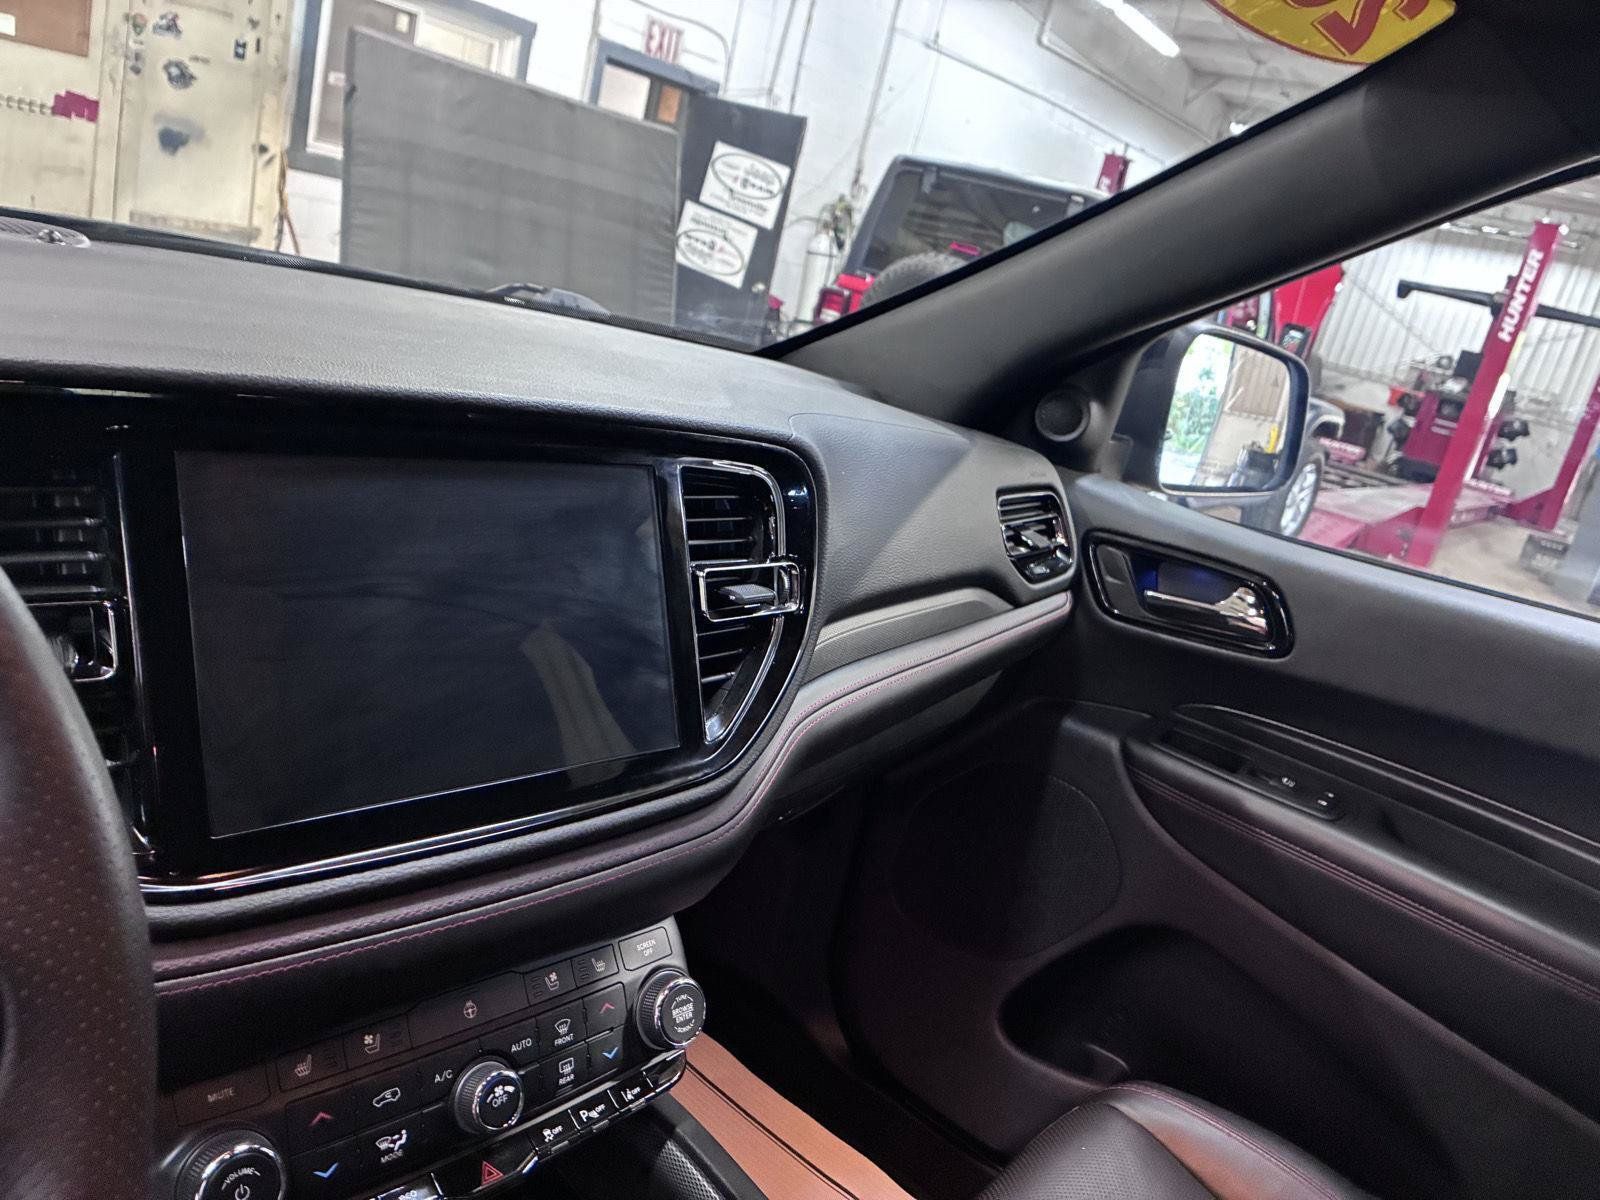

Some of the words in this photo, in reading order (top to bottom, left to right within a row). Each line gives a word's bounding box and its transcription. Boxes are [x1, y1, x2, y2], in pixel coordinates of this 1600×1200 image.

[645, 19, 684, 65] EXIT
[1497, 248, 1544, 343] HUNTER
[636, 939, 656, 951] SCREEN
[643, 947, 653, 957] OFF
[672, 1002, 694, 1016] BROWSE
[675, 1011, 693, 1024] ENTER
[511, 1038, 532, 1053] AUTO
[554, 1033, 574, 1046] FRONT
[434, 1069, 453, 1083] A/C
[558, 1073, 575, 1086] REAR
[207, 1088, 235, 1103] MUTE
[631, 1086, 641, 1096] OFF
[491, 1093, 509, 1108] OFF
[595, 1103, 606, 1113] OFF
[552, 1125, 563, 1135] OFF
[381, 1149, 403, 1163] MODE
[224, 1166, 256, 1184] VOLUME
